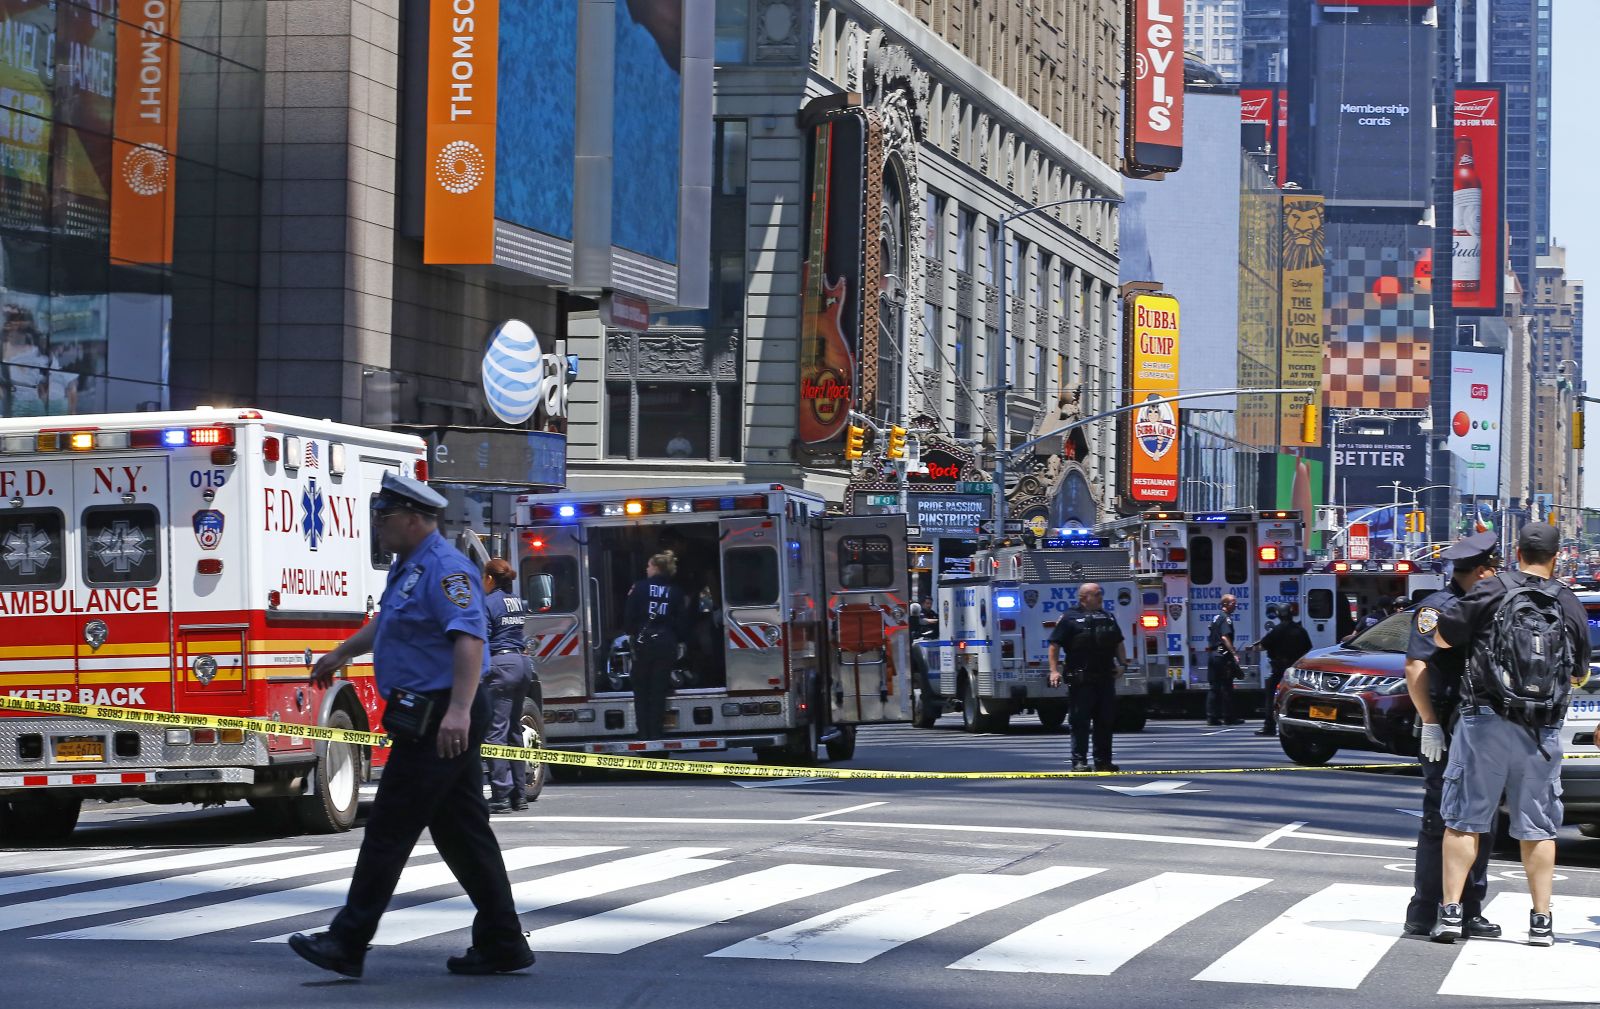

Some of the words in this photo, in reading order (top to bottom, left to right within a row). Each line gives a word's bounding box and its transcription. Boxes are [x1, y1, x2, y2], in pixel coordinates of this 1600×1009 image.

[1340, 103, 1410, 116] Membership
[1358, 116, 1391, 126] cards
[1291, 297, 1311, 307] THE
[1137, 305, 1177, 329] BUBBA
[1287, 309, 1315, 326] LION
[1140, 332, 1174, 355] GUMP
[1286, 328, 1319, 348] KING
[826, 377, 850, 400] Rock
[1335, 451, 1405, 466] BETTER
[927, 463, 959, 479] Rock
[0, 469, 53, 497] F.D.
[93, 466, 148, 494] N.Y.
[190, 470, 225, 488] 015
[1133, 478, 1176, 486] RESTAURANT
[975, 483, 985, 492] 43
[1140, 489, 1169, 497] MARKET
[882, 496, 890, 504] 43
[264, 488, 298, 533] F.D.
[328, 495, 360, 538] N.Y.
[918, 513, 980, 526] PINSTRIPES
[281, 568, 348, 597] AMBULANCE
[650, 584, 669, 598] FDNY
[1191, 587, 1221, 599] TRUCK
[1230, 587, 1249, 598] ONE
[0, 587, 158, 615] AMBULANCE
[503, 598, 523, 612] FDNY
[79, 687, 146, 706] BACK
[7, 699, 22, 709] NOT
[25, 700, 35, 709] DO
[37, 702, 61, 713] SCENE
[63, 704, 88, 715] CRIME
[97, 707, 122, 718] CROSS
[126, 710, 142, 720] NOT
[143, 712, 155, 721] DO
[156, 713, 180, 724] SCENE
[184, 715, 208, 726] CRIME
[217, 718, 244, 728] CROSS
[246, 721, 262, 731] NOT
[265, 723, 277, 732] DO
[279, 725, 304, 736] SCENE
[307, 727, 333, 739] CRIME
[343, 732, 371, 744] CROSS
[500, 747, 517, 757] NOT
[519, 749, 531, 759] DO
[532, 750, 558, 762] SCENE
[561, 753, 587, 765] CRIME
[597, 756, 624, 767] CROSS
[627, 759, 643, 769] NOT
[646, 759, 657, 769] DO
[659, 760, 685, 771] SCENE
[688, 763, 714, 774] CRIME
[723, 765, 750, 776] CROSS
[753, 766, 769, 777] NOT
[771, 768, 783, 777] DO
[785, 768, 811, 778] SCENE
